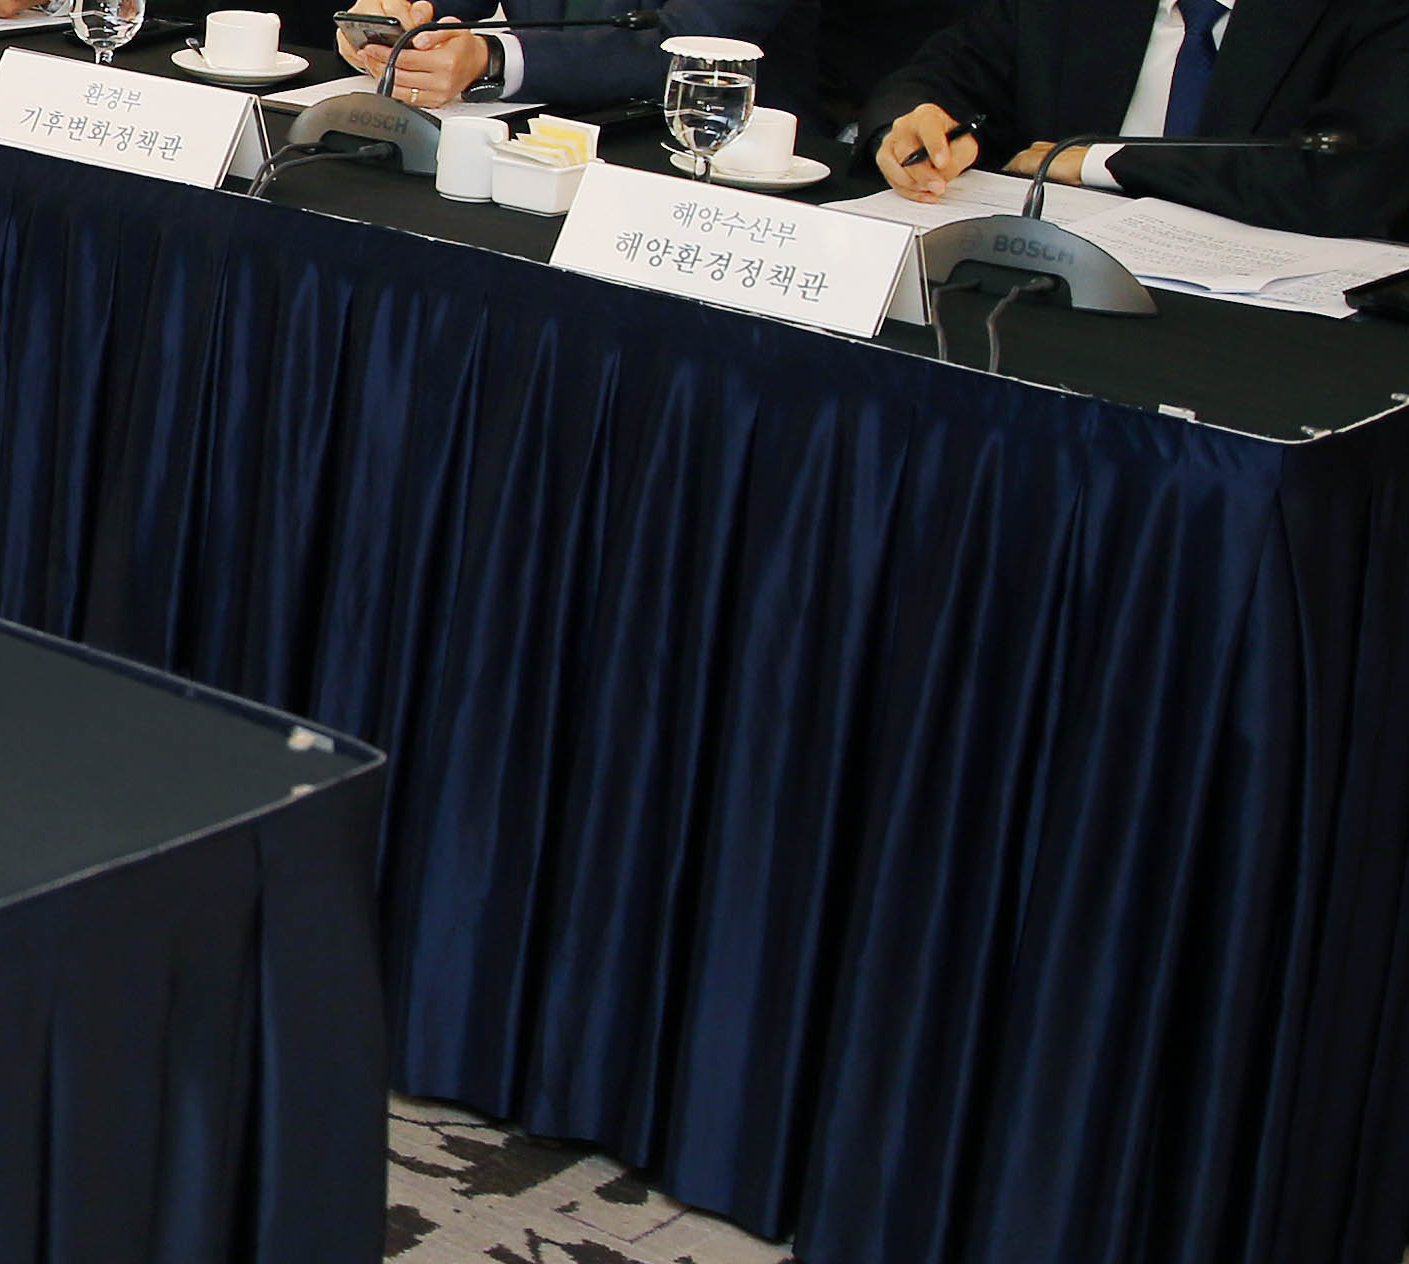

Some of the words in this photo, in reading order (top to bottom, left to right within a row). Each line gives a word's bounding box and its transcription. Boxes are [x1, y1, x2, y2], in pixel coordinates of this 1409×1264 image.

[84, 82, 142, 113] 환경부
[20, 107, 183, 162] 기후변화정책관
[349, 111, 410, 135] BOSCH
[672, 201, 797, 249] 해양수산부
[615, 232, 829, 303] 해양환경정책관
[993, 235, 1077, 265] BOSCH
